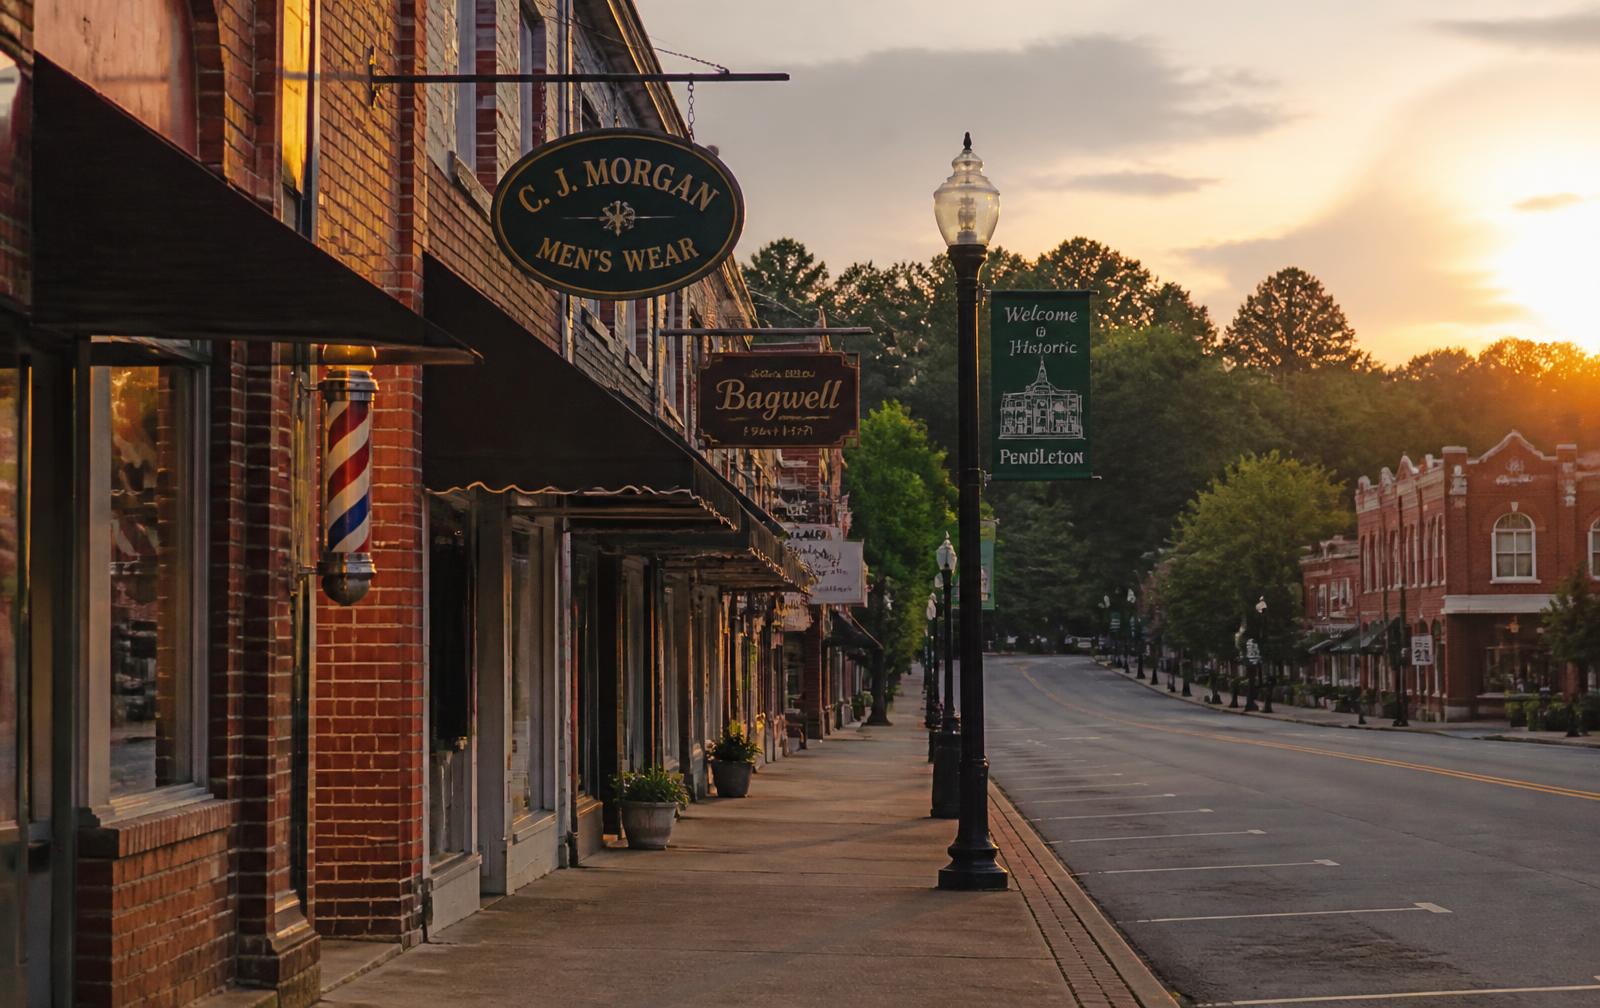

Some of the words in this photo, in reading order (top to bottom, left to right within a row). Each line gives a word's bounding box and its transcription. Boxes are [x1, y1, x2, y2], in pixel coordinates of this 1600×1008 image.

[518, 184, 550, 213] C.
[554, 167, 578, 198] J.
[583, 157, 720, 212] MORGAN
[535, 237, 613, 273] MEN'S
[622, 237, 700, 273] WEAR
[1004, 304, 1079, 323] Welcome
[715, 379, 843, 421] Bagwell
